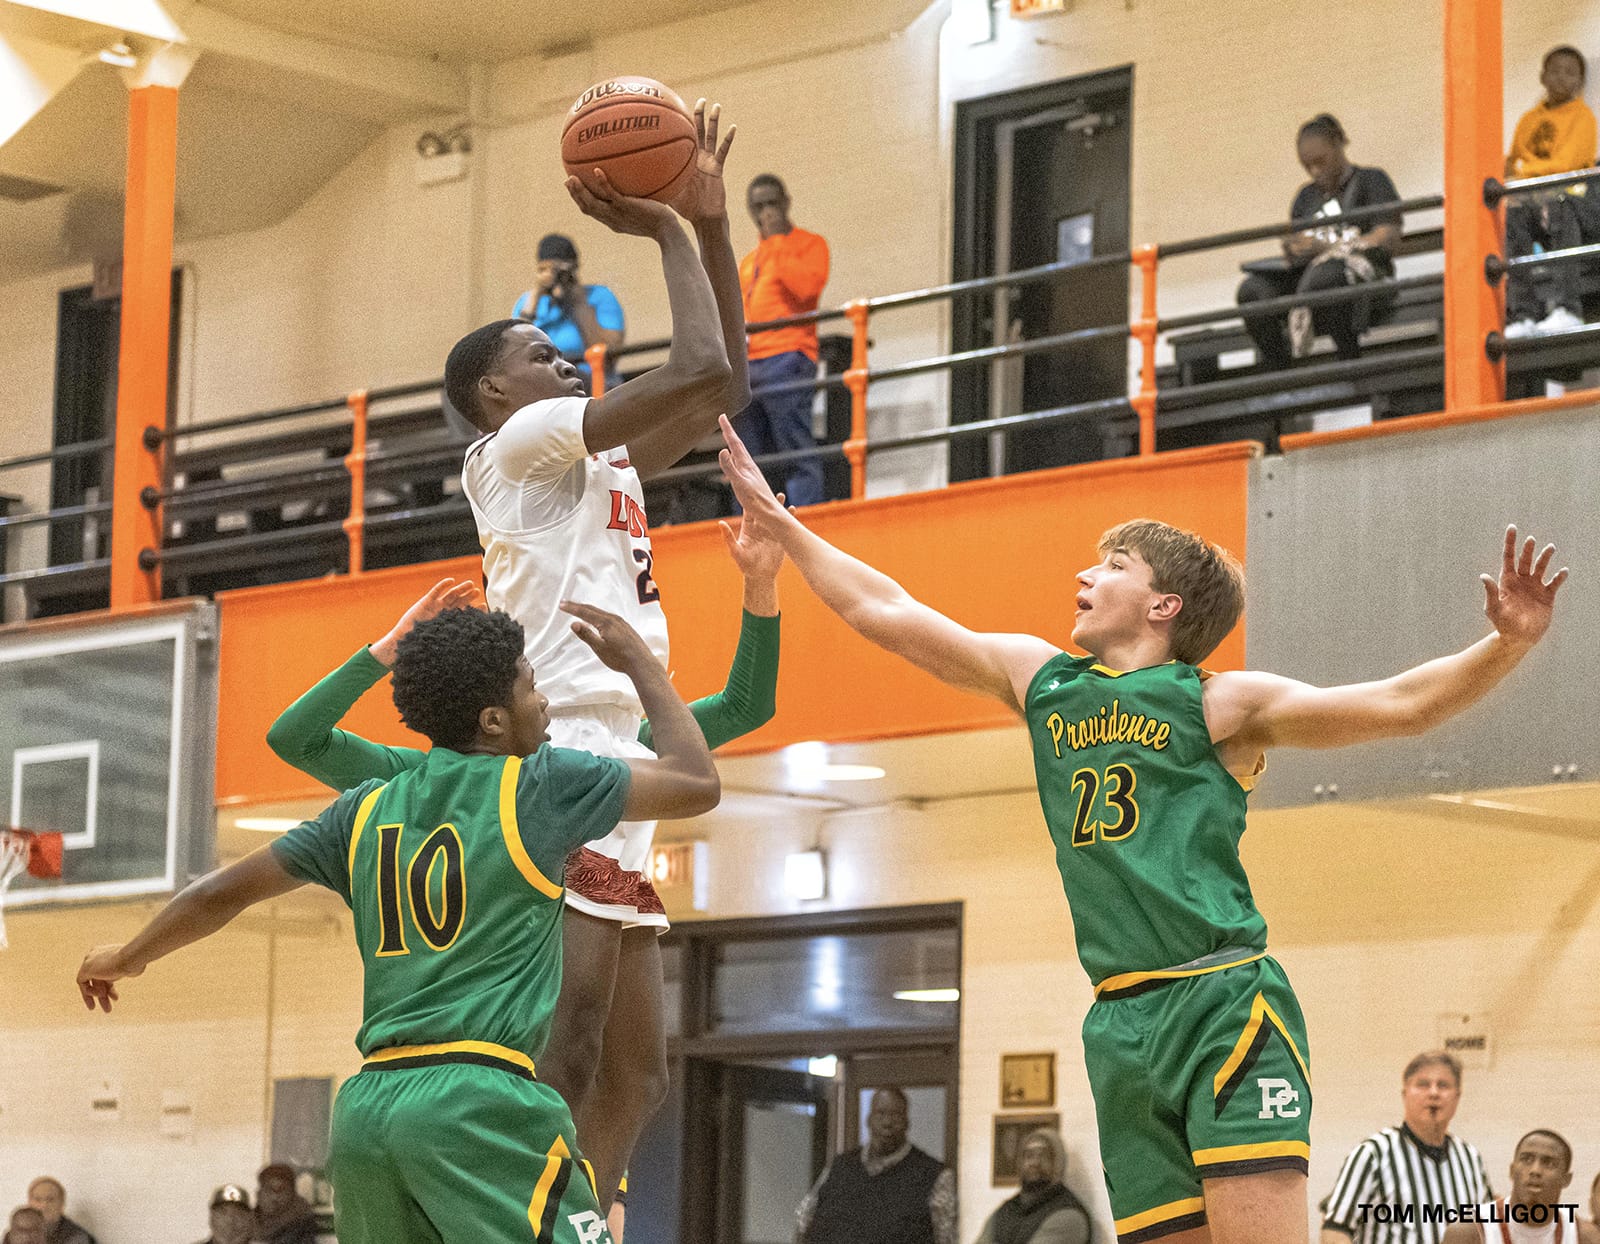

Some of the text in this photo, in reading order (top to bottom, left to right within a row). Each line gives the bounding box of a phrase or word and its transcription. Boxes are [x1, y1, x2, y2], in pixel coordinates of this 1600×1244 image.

[577, 115, 660, 143] EVOLUTION
[1046, 698, 1172, 758] Providence
[1070, 763, 1140, 847] 23
[375, 822, 467, 957] 10
[1257, 1078, 1301, 1119] PC
